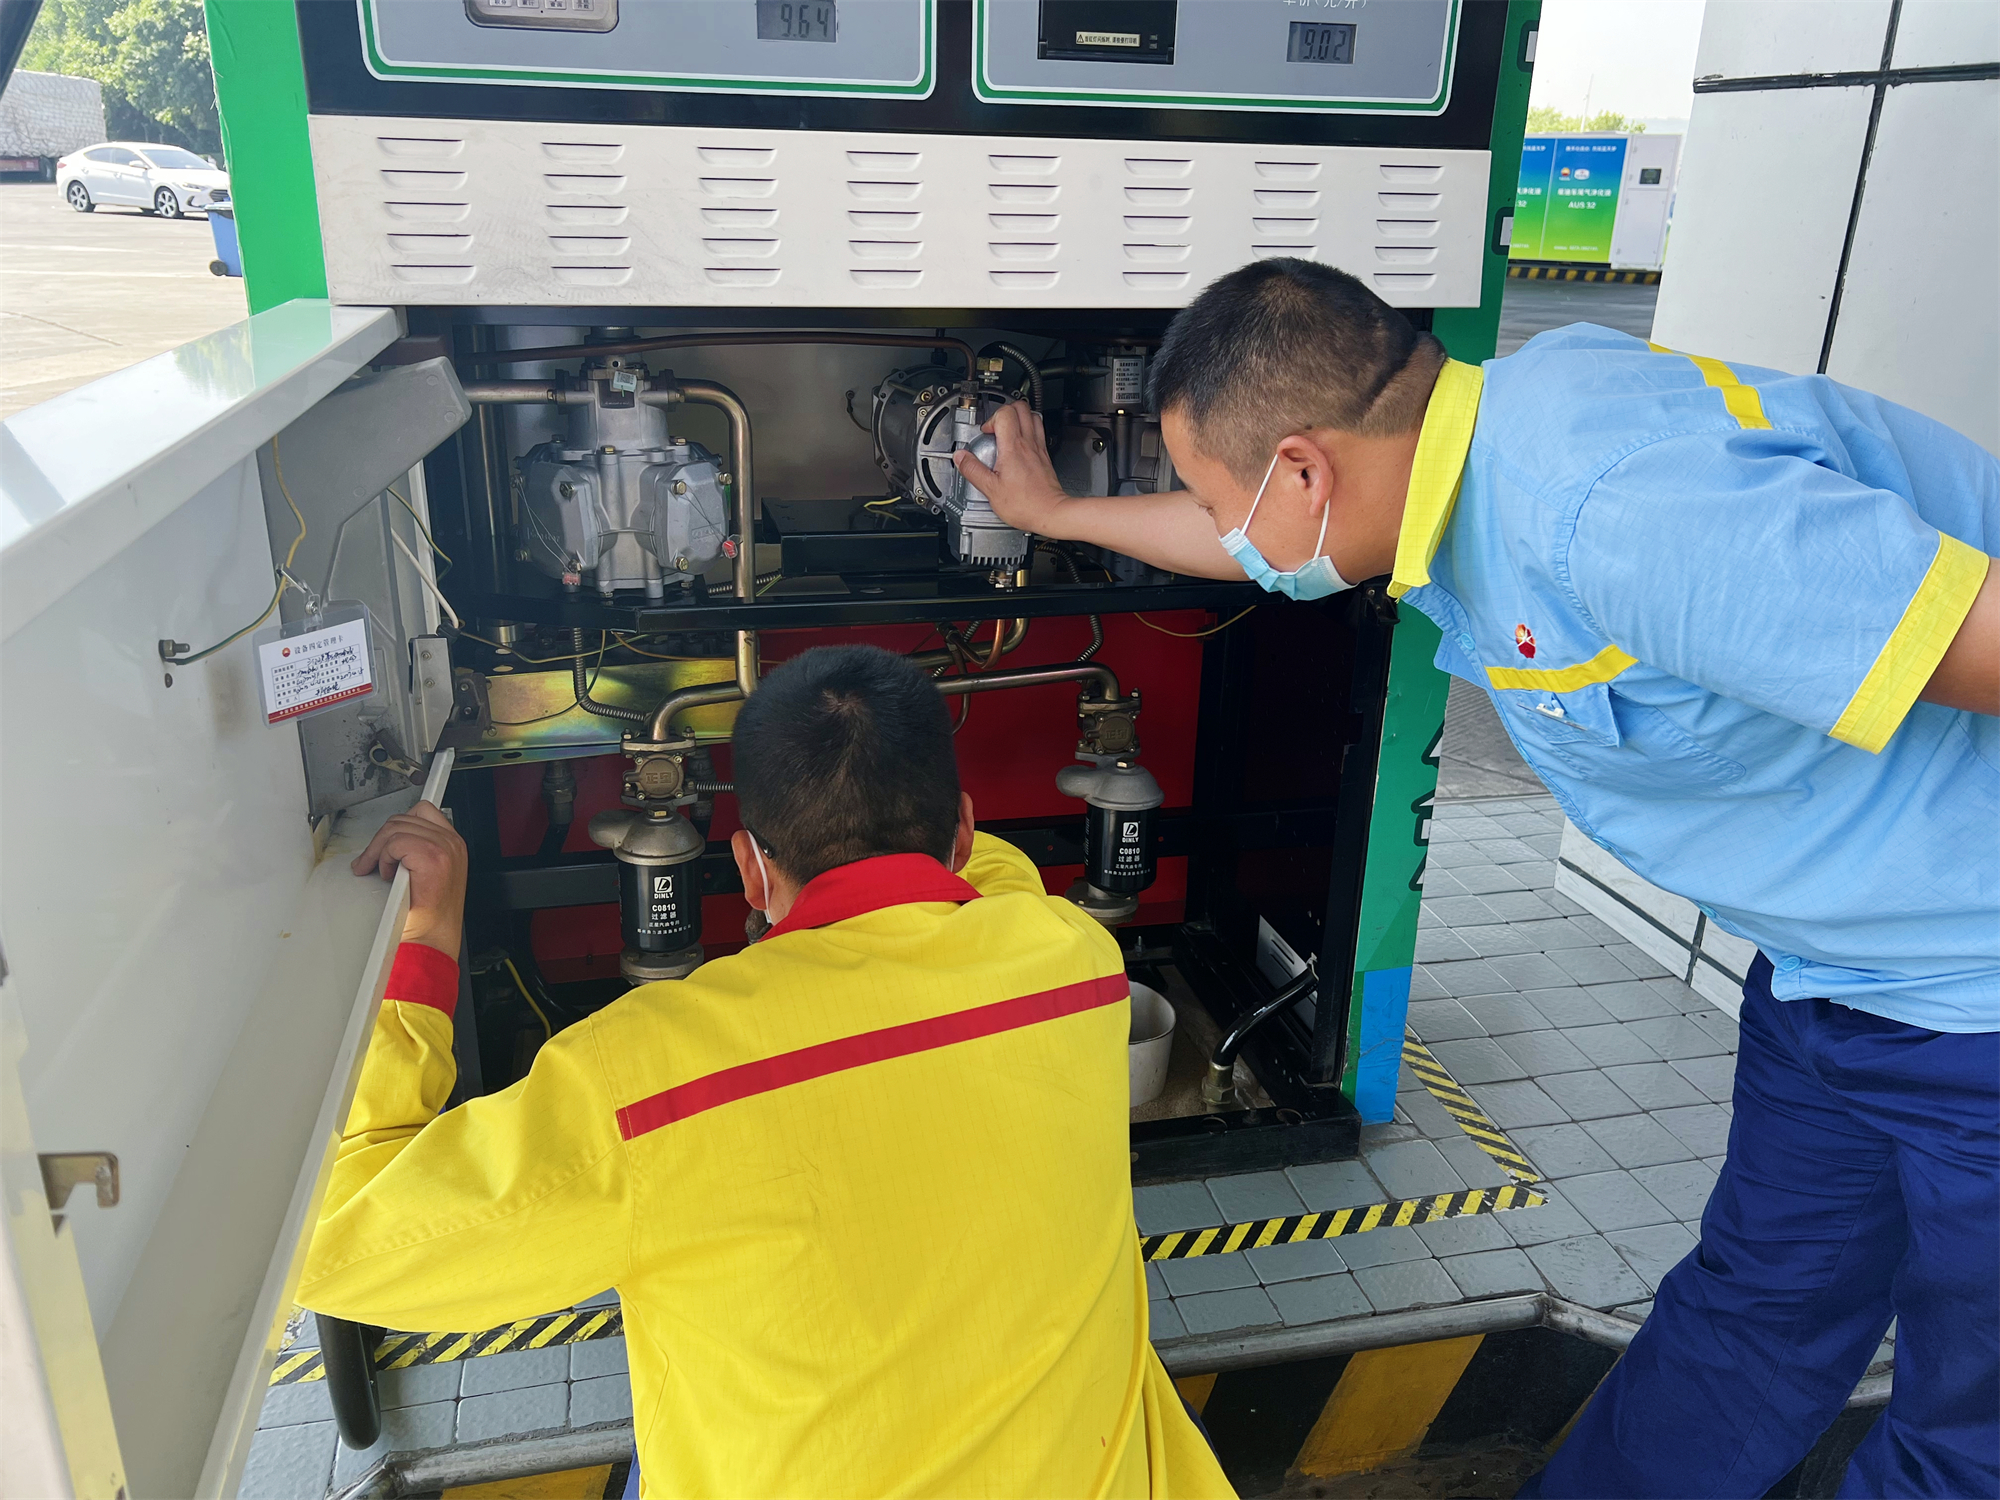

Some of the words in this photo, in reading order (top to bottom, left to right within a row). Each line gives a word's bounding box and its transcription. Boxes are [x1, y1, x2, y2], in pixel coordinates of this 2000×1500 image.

[780, 3, 829, 38] 9.64
[1302, 28, 1347, 60] 9.02
[1568, 201, 1585, 209] AUS
[1586, 201, 1596, 209] 32
[1119, 847, 1140, 855] C0810
[651, 903, 676, 912] C0810
[651, 911, 677, 920] 过滤器
